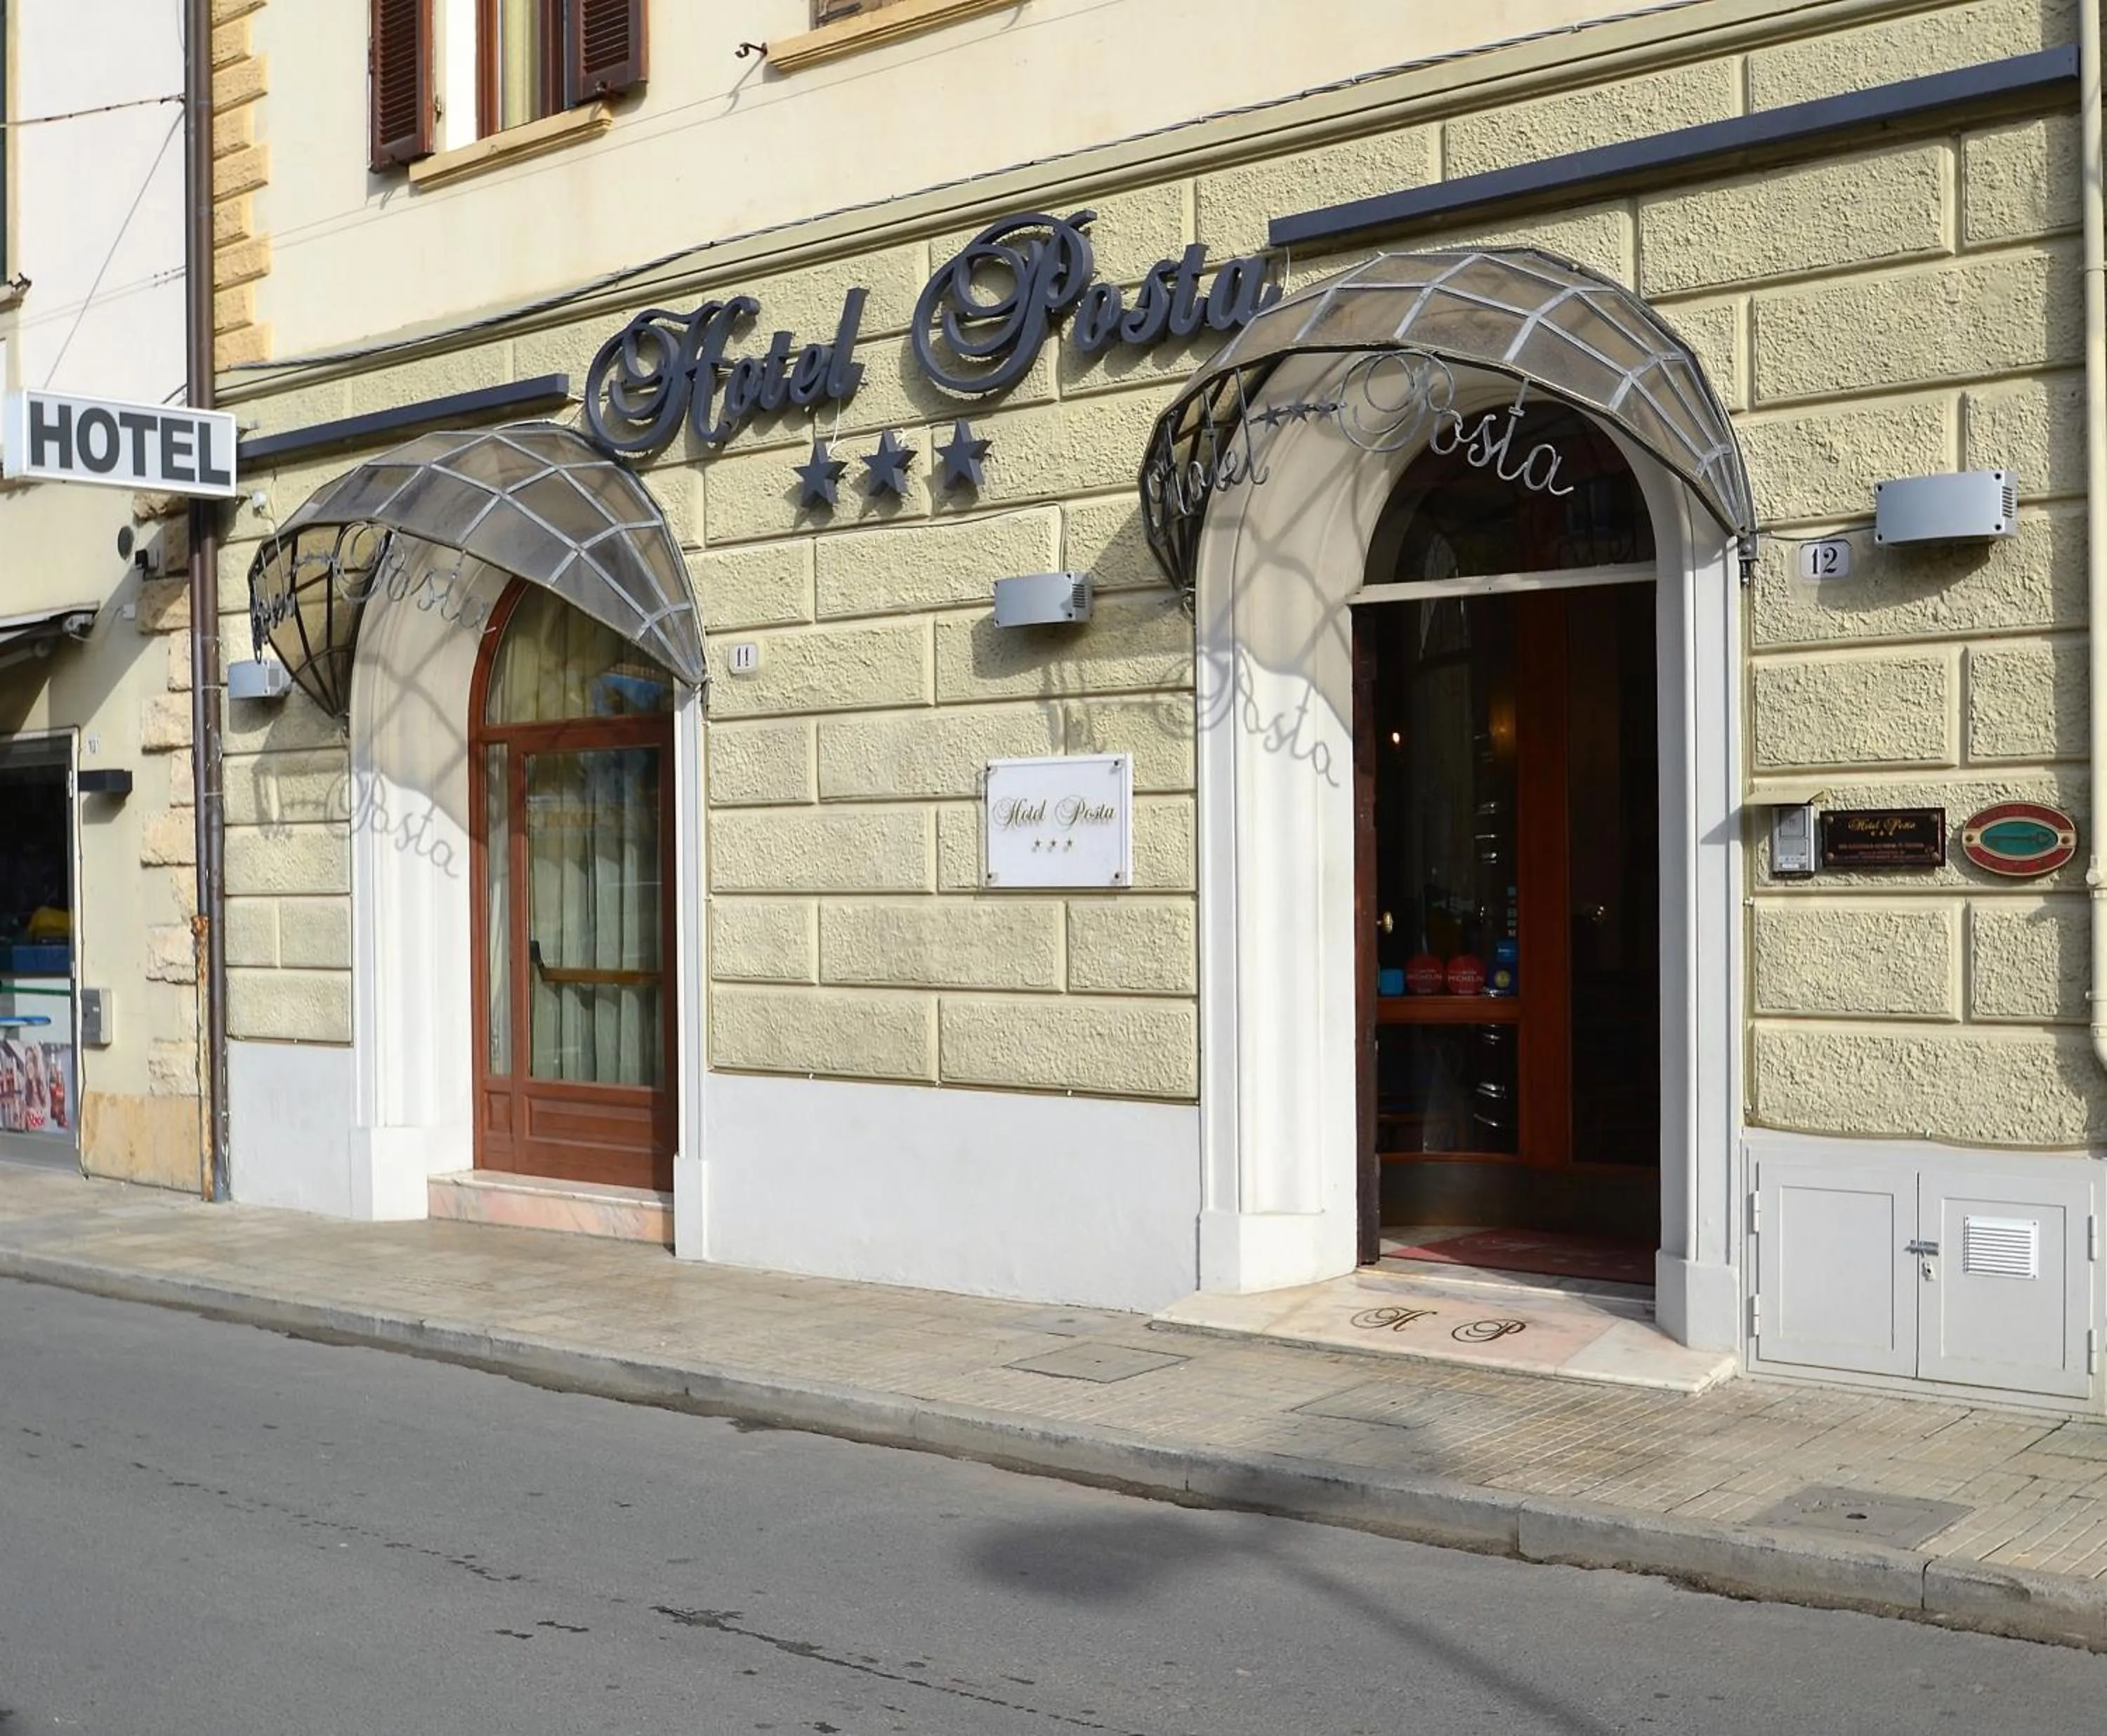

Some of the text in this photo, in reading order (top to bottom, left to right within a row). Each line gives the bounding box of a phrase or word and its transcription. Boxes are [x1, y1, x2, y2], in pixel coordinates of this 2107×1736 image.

[585, 209, 1284, 453] Hotel Posta
[1337, 350, 1574, 496] Posta
[29, 401, 231, 485] HOTEL
[1811, 547, 1839, 575] 12
[737, 647, 750, 666] 11
[992, 794, 1115, 831] Hotel Posta
[1848, 817, 1917, 833] Hotel Posta
[1451, 1318, 1526, 1343] P
